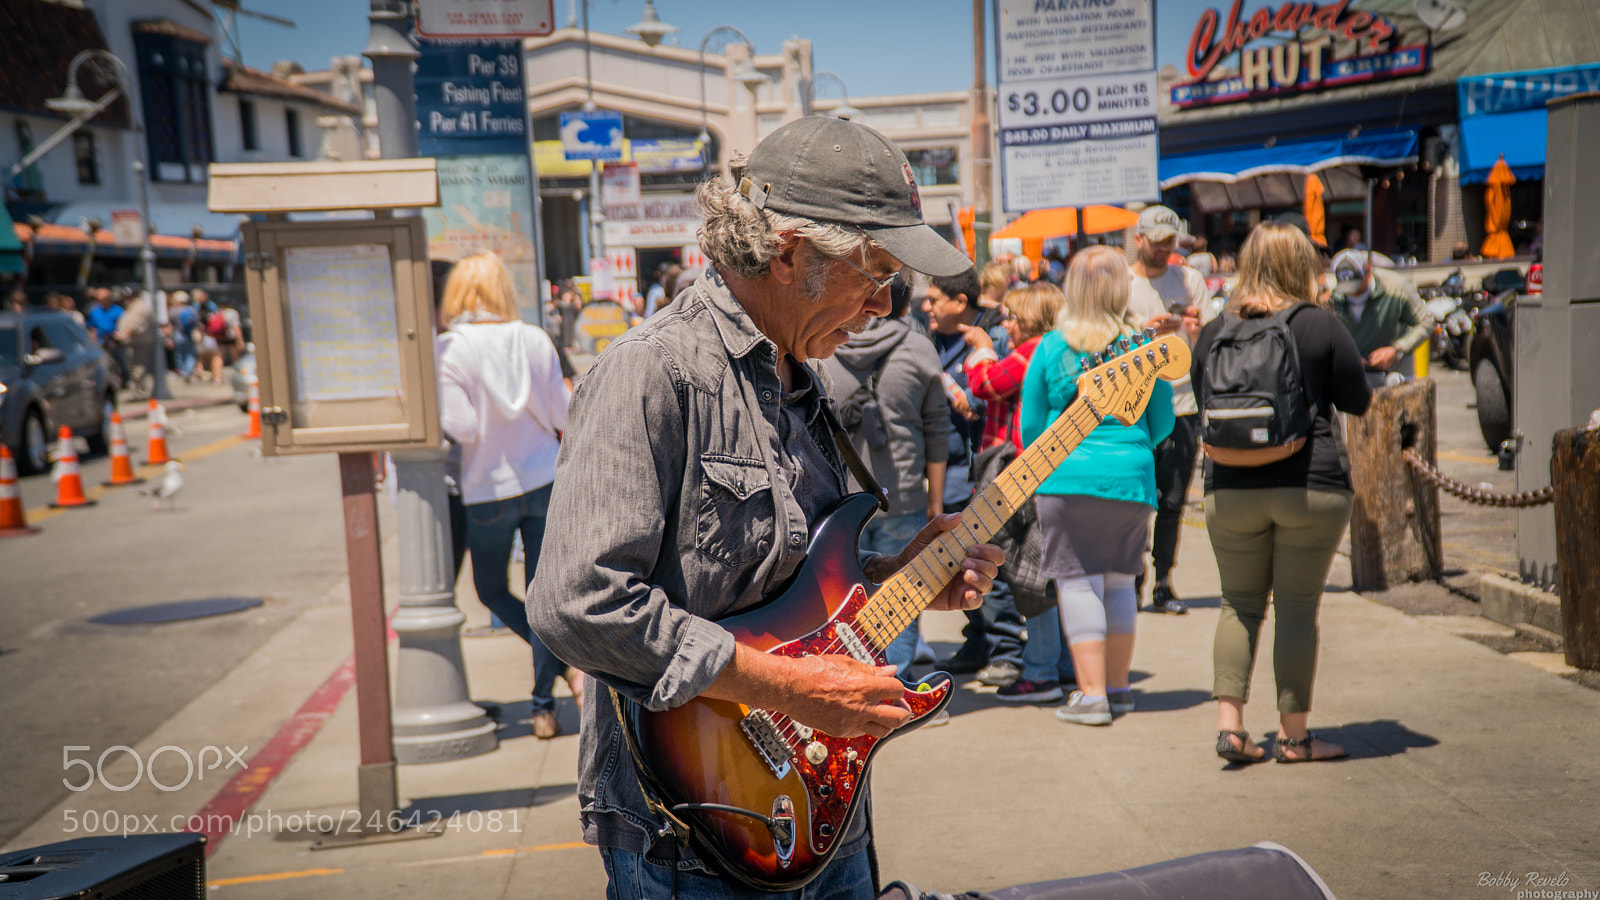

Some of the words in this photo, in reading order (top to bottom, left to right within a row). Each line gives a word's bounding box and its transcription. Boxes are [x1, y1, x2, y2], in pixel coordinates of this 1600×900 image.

[1034, 0, 1116, 13] PARKING
[1017, 17, 1041, 27] WITH
[1046, 12, 1102, 25] VALIDATION
[1108, 8, 1135, 19] FROM
[1006, 26, 1077, 41] PARTICIPATING
[1081, 20, 1147, 34] RESTAURANTS
[1187, 0, 1393, 79] Chowder
[1090, 45, 1147, 57] VALIDATION
[468, 54, 496, 75] Pier
[500, 54, 518, 75] 39
[1243, 35, 1331, 91] HUT
[442, 82, 490, 105] Fishing
[492, 82, 523, 102] Fleet
[1007, 86, 1091, 117] $3.00
[1097, 84, 1129, 97] EACH
[1098, 97, 1150, 111] MINUTES
[430, 111, 457, 133] Pier
[460, 112, 477, 132] 41
[482, 111, 524, 133] Ferries
[1052, 124, 1088, 141] DAILY
[1090, 120, 1155, 137] MAXIMUM
[1124, 384, 1146, 419] Fender
